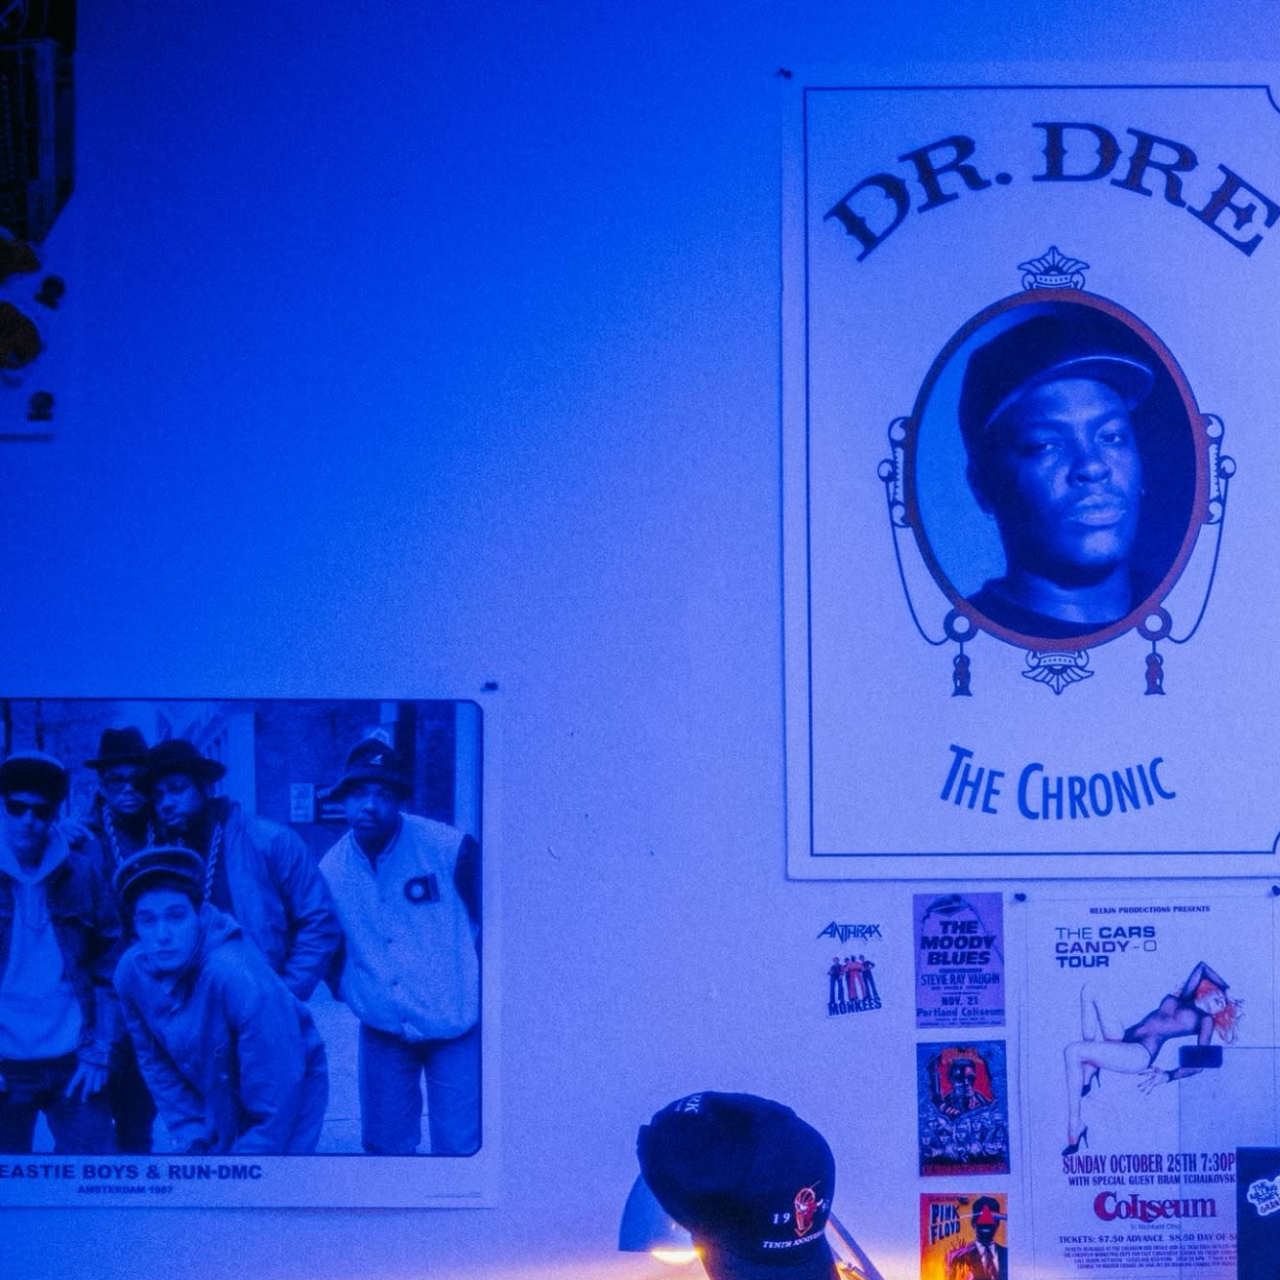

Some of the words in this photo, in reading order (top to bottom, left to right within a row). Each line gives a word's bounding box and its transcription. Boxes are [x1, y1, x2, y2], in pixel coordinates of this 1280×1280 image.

[824, 134, 1013, 263] DR.
[940, 743, 1006, 815] THE
[1016, 757, 1177, 820] CHRONIC
[816, 920, 883, 944] ANTHRAX
[940, 920, 978, 934] THE
[1055, 926, 1092, 939] THE
[1098, 926, 1156, 939] CARS
[920, 935, 997, 949] MOODY
[927, 950, 991, 966] BLUES
[1055, 955, 1110, 968] TOUR
[920, 974, 950, 986] STEVIE
[950, 973, 966, 985] RAY
[827, 997, 882, 1017] MONKEES
[916, 1007, 958, 1017] Portland
[82, 1163, 139, 1181] BOYS
[145, 1163, 161, 1181] &
[168, 1163, 263, 1181] RUN-DMC
[1062, 1154, 1107, 1175] SUNDAY
[1110, 1153, 1163, 1174] OCTOBER
[1092, 1175, 1127, 1187] SPECIAL
[1093, 1190, 1217, 1223] Coliseum
